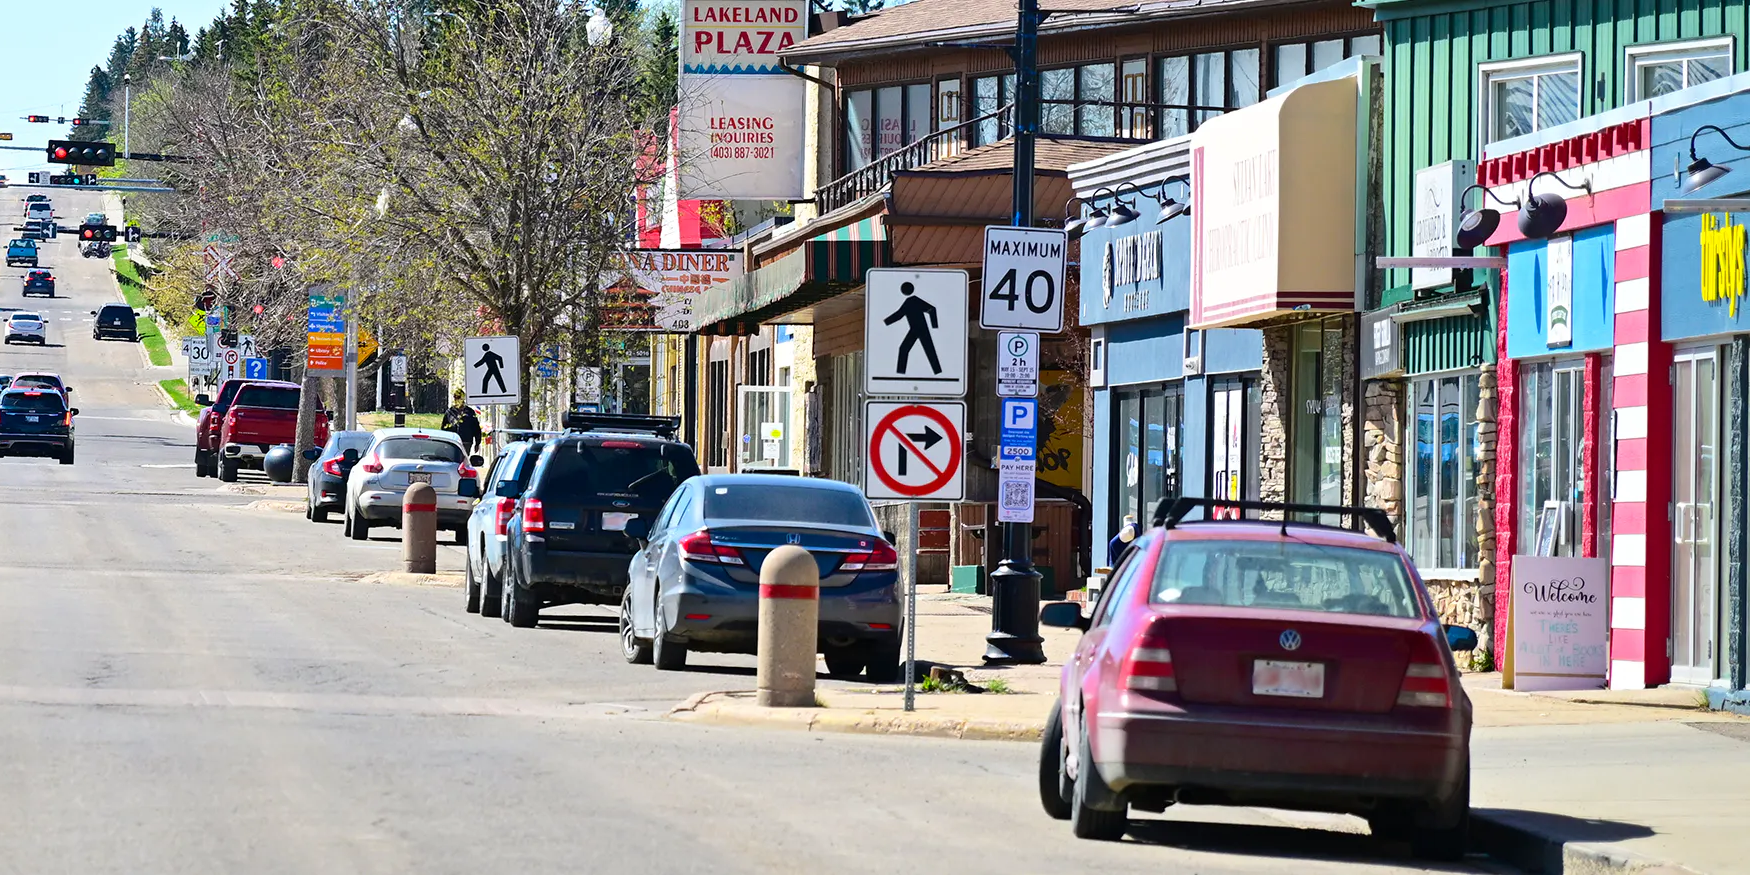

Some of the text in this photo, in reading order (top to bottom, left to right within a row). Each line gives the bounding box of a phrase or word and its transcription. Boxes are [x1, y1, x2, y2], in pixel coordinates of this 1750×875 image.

[693, 7, 799, 23] LAKELAND
[694, 30, 797, 55] PLAZA
[710, 117, 775, 130] LEASING
[710, 133, 775, 144] INQUIRIES
[710, 146, 775, 159] (403) 887-3021
[990, 240, 1061, 258] MAXIMUM
[660, 253, 730, 273] DINER
[1700, 211, 1745, 318] thirstys
[988, 268, 1055, 314] 40
[192, 346, 210, 360] 30
[1014, 340, 1025, 353] P
[1012, 357, 1027, 367] 2 h
[1012, 405, 1028, 425] P
[1007, 447, 1030, 455] 2500
[1523, 576, 1598, 604] Welcome
